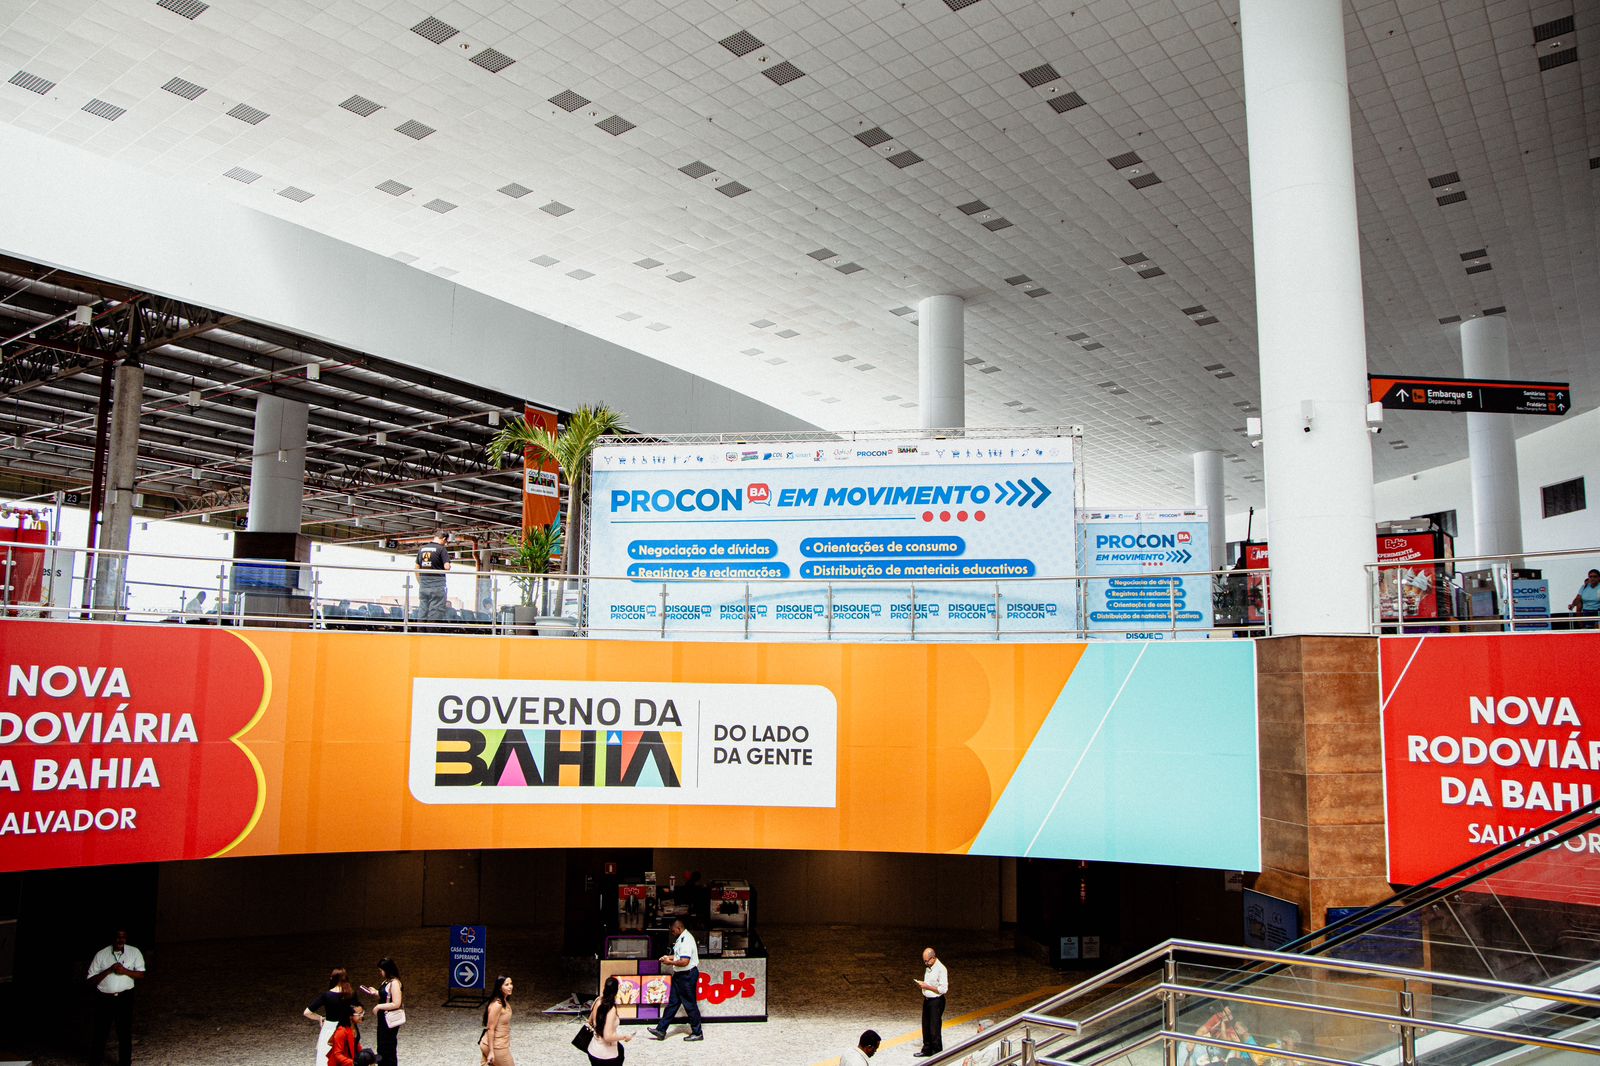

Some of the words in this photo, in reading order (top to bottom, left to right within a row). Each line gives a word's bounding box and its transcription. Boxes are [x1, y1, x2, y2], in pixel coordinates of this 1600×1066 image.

[1427, 390, 1465, 399] Embarque
[1467, 391, 1473, 399] B
[529, 476, 556, 488] BAHIA
[67, 494, 77, 503] 23
[611, 488, 742, 513] PROCON
[749, 487, 767, 497] BA
[777, 488, 818, 507] EM
[824, 485, 990, 507] MOVIMENTO
[813, 541, 884, 554] Orientações
[887, 541, 902, 552] de
[906, 543, 958, 552] consumo
[1096, 534, 1175, 548] PROCON
[638, 544, 707, 557] Negociação
[709, 544, 724, 554] de
[727, 544, 770, 554] dívidas
[638, 566, 689, 578] Registros
[692, 567, 707, 578] de
[710, 566, 781, 578] reclamações
[813, 564, 882, 578] Distribuição
[885, 564, 902, 575] de
[904, 564, 960, 575] materiais
[962, 563, 1028, 575] educativos
[610, 605, 646, 613] DISQUE
[664, 605, 700, 613] DISQUE
[776, 604, 812, 613] DISQUE
[833, 604, 870, 612] DISQUE
[949, 604, 986, 612] DISQUE
[8, 664, 130, 698] NOVA
[437, 695, 621, 726] GOVERNO
[634, 698, 682, 727] DA
[1469, 696, 1581, 726] NOVA
[0, 703, 199, 744] DOVIÁRIA
[714, 724, 736, 742] DO
[751, 725, 809, 742] LADO
[435, 728, 682, 787] BAHIA
[713, 748, 742, 765] DA
[746, 748, 813, 766] GENTE
[0, 760, 20, 792] A
[32, 757, 160, 791] BAHIA
[1441, 776, 1493, 807] DA
[1501, 779, 1600, 815] BAHI
[0, 808, 137, 836] ALVADOR
[696, 971, 755, 1005] Bob's
